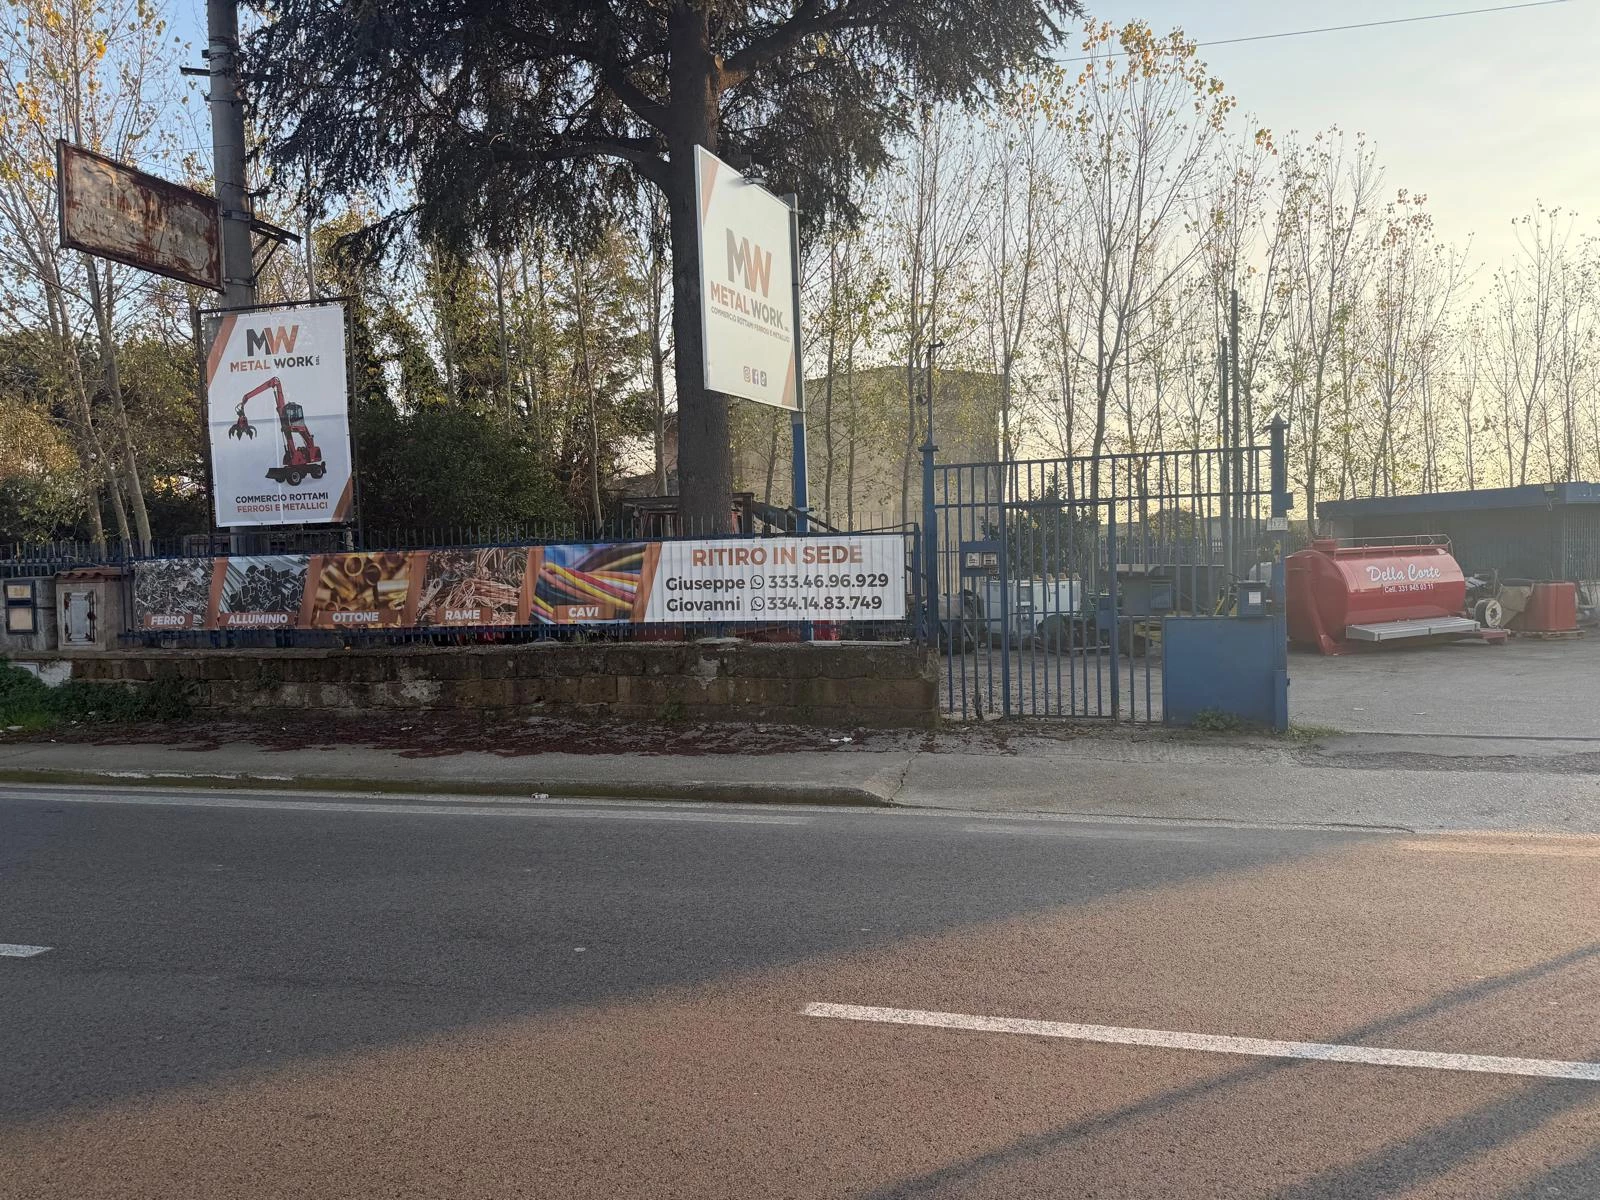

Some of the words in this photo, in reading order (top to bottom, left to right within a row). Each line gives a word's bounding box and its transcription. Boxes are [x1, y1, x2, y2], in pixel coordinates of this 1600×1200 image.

[726, 227, 772, 299] MW
[710, 279, 750, 316] METAL
[751, 298, 784, 330] WORK
[246, 324, 299, 357] MW
[230, 360, 271, 373] METAL
[273, 355, 314, 369] WORK
[235, 494, 287, 504] COMMERCIO
[289, 492, 329, 501] ROTTAMI
[237, 504, 273, 513] FERROSI
[275, 504, 281, 512] E
[282, 502, 328, 511] METALLICI
[692, 546, 767, 567] RITIRO
[773, 546, 797, 566] IN
[802, 545, 864, 565] SEDE
[1366, 565, 1406, 582] Della
[1407, 563, 1441, 581] Corte
[665, 575, 746, 593] Giuseppe
[767, 573, 889, 589] 333.46.96.929
[568, 606, 599, 618] CAVI
[666, 596, 741, 612] Giovanni
[767, 595, 883, 611] 334.14.83.749
[150, 615, 186, 626] FERRO
[227, 613, 289, 625] ALLUMINIO
[332, 611, 380, 622] OTTONE
[445, 609, 481, 620] RAME
